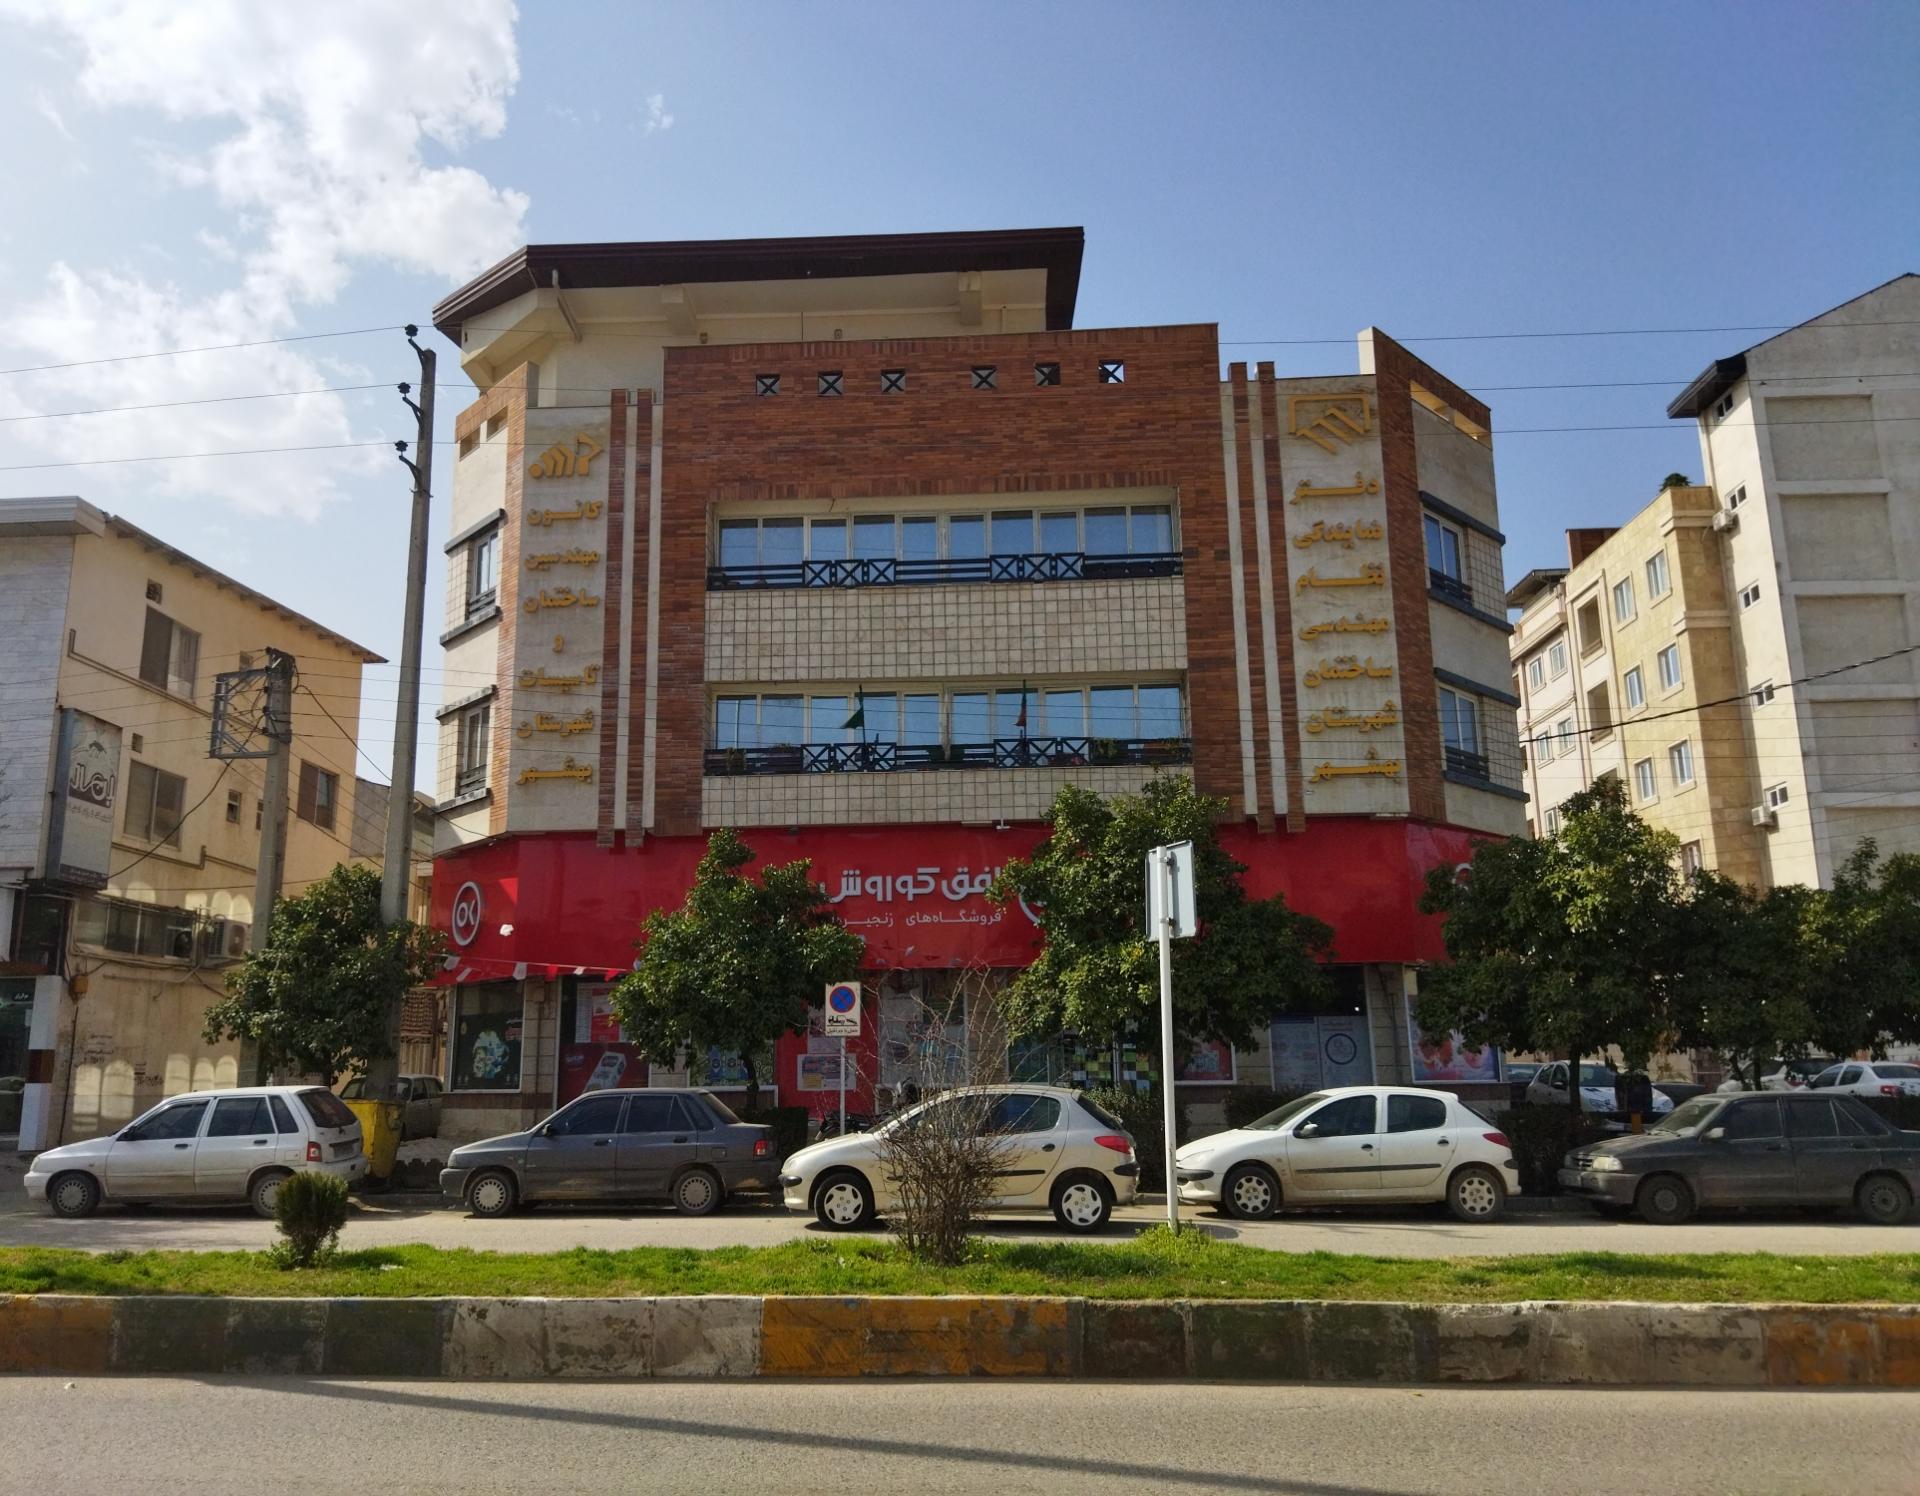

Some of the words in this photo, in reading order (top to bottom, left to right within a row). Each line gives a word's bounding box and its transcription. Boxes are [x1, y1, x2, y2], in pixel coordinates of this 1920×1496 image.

[1289, 471, 1380, 506] دفتر
[526, 499, 603, 527] کانون
[1293, 518, 1384, 550] نمایندگی
[524, 547, 600, 572] مهندسین
[1295, 562, 1386, 597] نظام
[523, 586, 600, 612] ساختمان
[1298, 612, 1390, 641] مهندسی
[552, 634, 564, 654] و
[1303, 655, 1393, 688] ساختمان
[516, 706, 594, 739] شهرستان
[1305, 699, 1398, 734] شهرستان
[515, 756, 594, 786] بهشهر
[1309, 746, 1402, 784] بهشهر
[829, 867, 941, 903] کوروش
